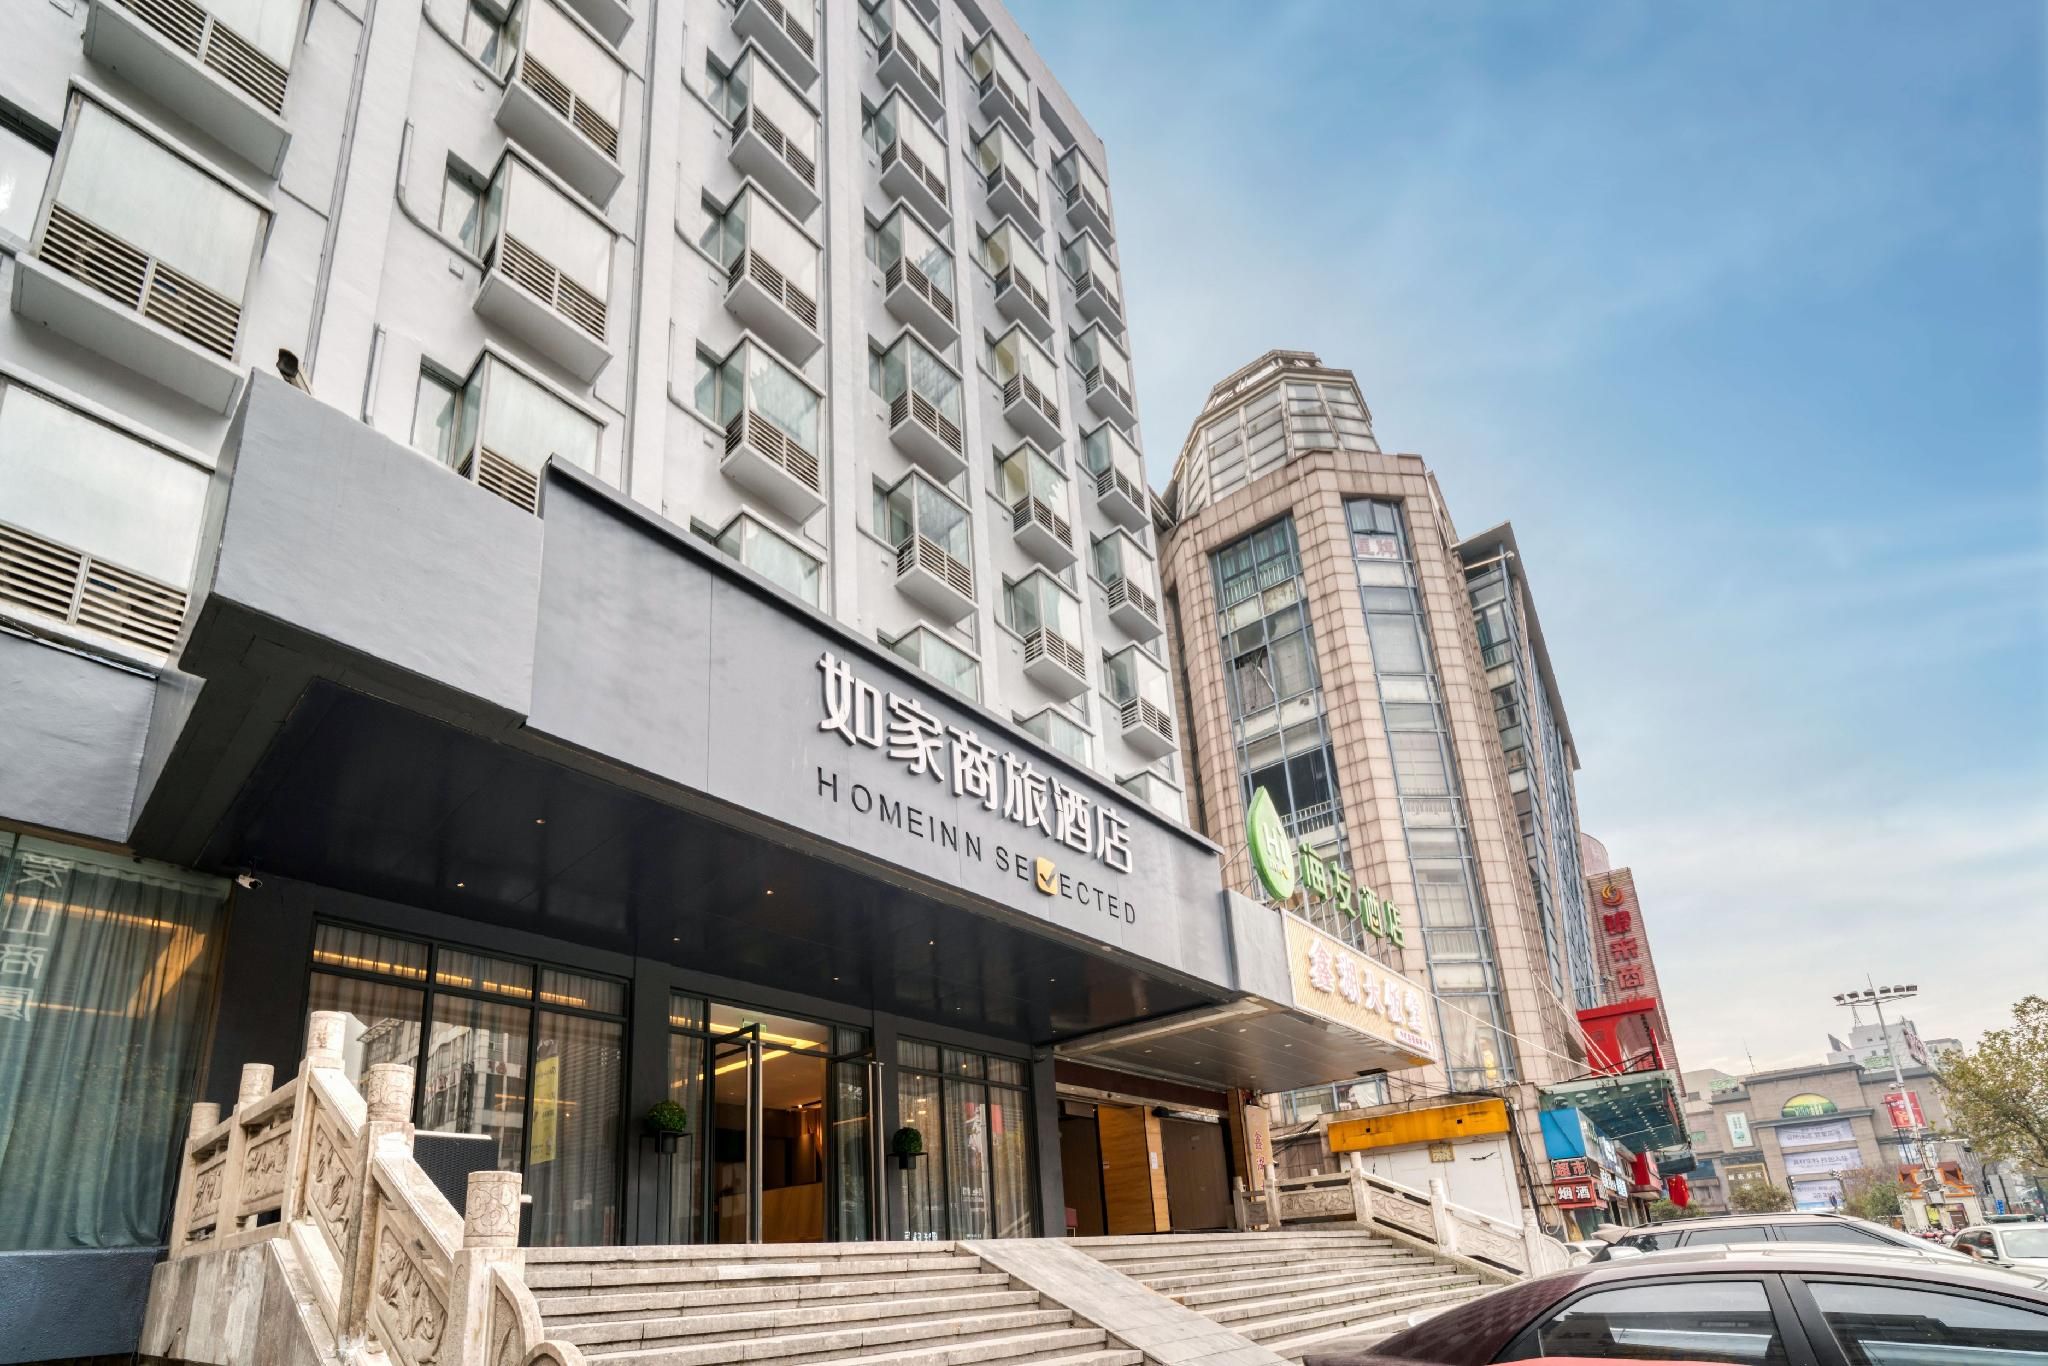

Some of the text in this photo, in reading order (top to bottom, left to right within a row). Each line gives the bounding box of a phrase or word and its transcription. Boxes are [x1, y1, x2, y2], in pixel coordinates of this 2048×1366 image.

[818, 651, 1134, 874] 如家商旅酒店
[1554, 1160, 1586, 1177] 超市
[1558, 1185, 1591, 1200] 烟酒
